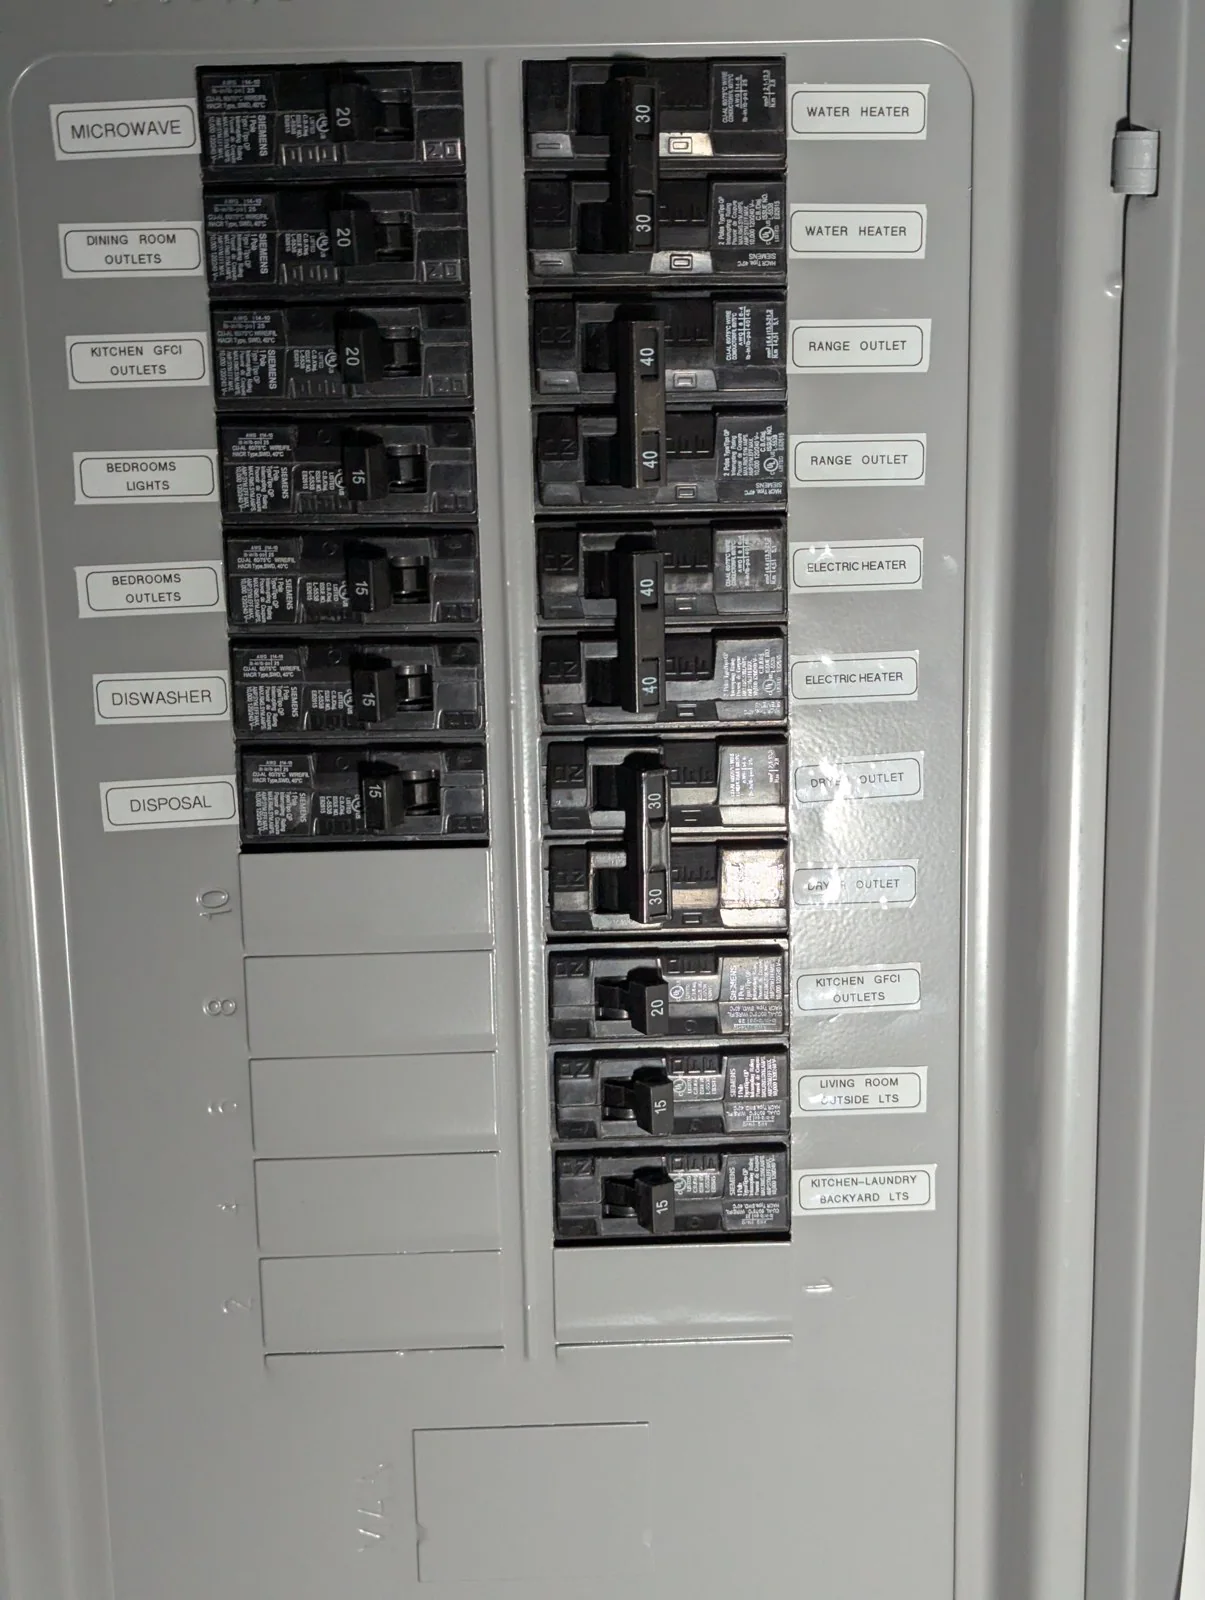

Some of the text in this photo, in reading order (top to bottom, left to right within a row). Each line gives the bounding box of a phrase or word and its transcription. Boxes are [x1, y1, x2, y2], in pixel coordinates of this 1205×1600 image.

[336, 108, 350, 126] 20
[636, 105, 650, 122] 30
[807, 107, 909, 117] WATER HEATER
[71, 120, 181, 139] MICROWAVE
[258, 114, 268, 156] SIEMENS
[636, 215, 651, 232] 30
[337, 228, 351, 246] 20
[805, 226, 906, 236] WATER HEATER
[87, 234, 176, 245] DINING ROOM
[105, 254, 161, 264] OUTLETS
[259, 232, 268, 275] SIEMENS
[91, 345, 182, 357] KITCHEN GFCI
[809, 340, 906, 351] RANGE OUTLET
[346, 348, 359, 365] 20
[640, 348, 654, 366] 40
[110, 365, 166, 376] OUTLETS
[268, 350, 277, 389] SIEMENS
[107, 461, 176, 472] BEDROOMS
[643, 451, 657, 468] 40
[811, 455, 908, 465] RANGE OUTLET
[281, 467, 289, 499] SIEMENS
[353, 470, 365, 484] 15
[127, 481, 169, 491] LIGHTS
[808, 560, 906, 572] ELECTRIC HEATER
[112, 574, 181, 585] BEDROOMS
[356, 581, 368, 595] 15
[640, 579, 653, 596] 40
[126, 592, 181, 603] OUTLETS
[642, 677, 657, 693] 40
[806, 672, 903, 684] ELECTRIC HEATER
[112, 690, 212, 705] DISWASHER
[363, 693, 375, 706] 15
[859, 772, 904, 784] OUTLET
[369, 785, 381, 797] 15
[130, 796, 212, 812] DISPOSAL
[648, 794, 661, 808] 30
[856, 879, 900, 889] OUTLET
[197, 888, 232, 920] 10
[649, 889, 662, 905] 30
[816, 974, 900, 987] KITCHEN GFCI
[833, 992, 885, 1003] OUTLETS
[651, 1000, 663, 1016] 20
[820, 1078, 898, 1088] LIVING ROOM
[879, 1094, 899, 1103] LTS
[655, 1100, 666, 1114] 15
[820, 1192, 909, 1204] BACKYARD LTS
[656, 1200, 668, 1214] 15
